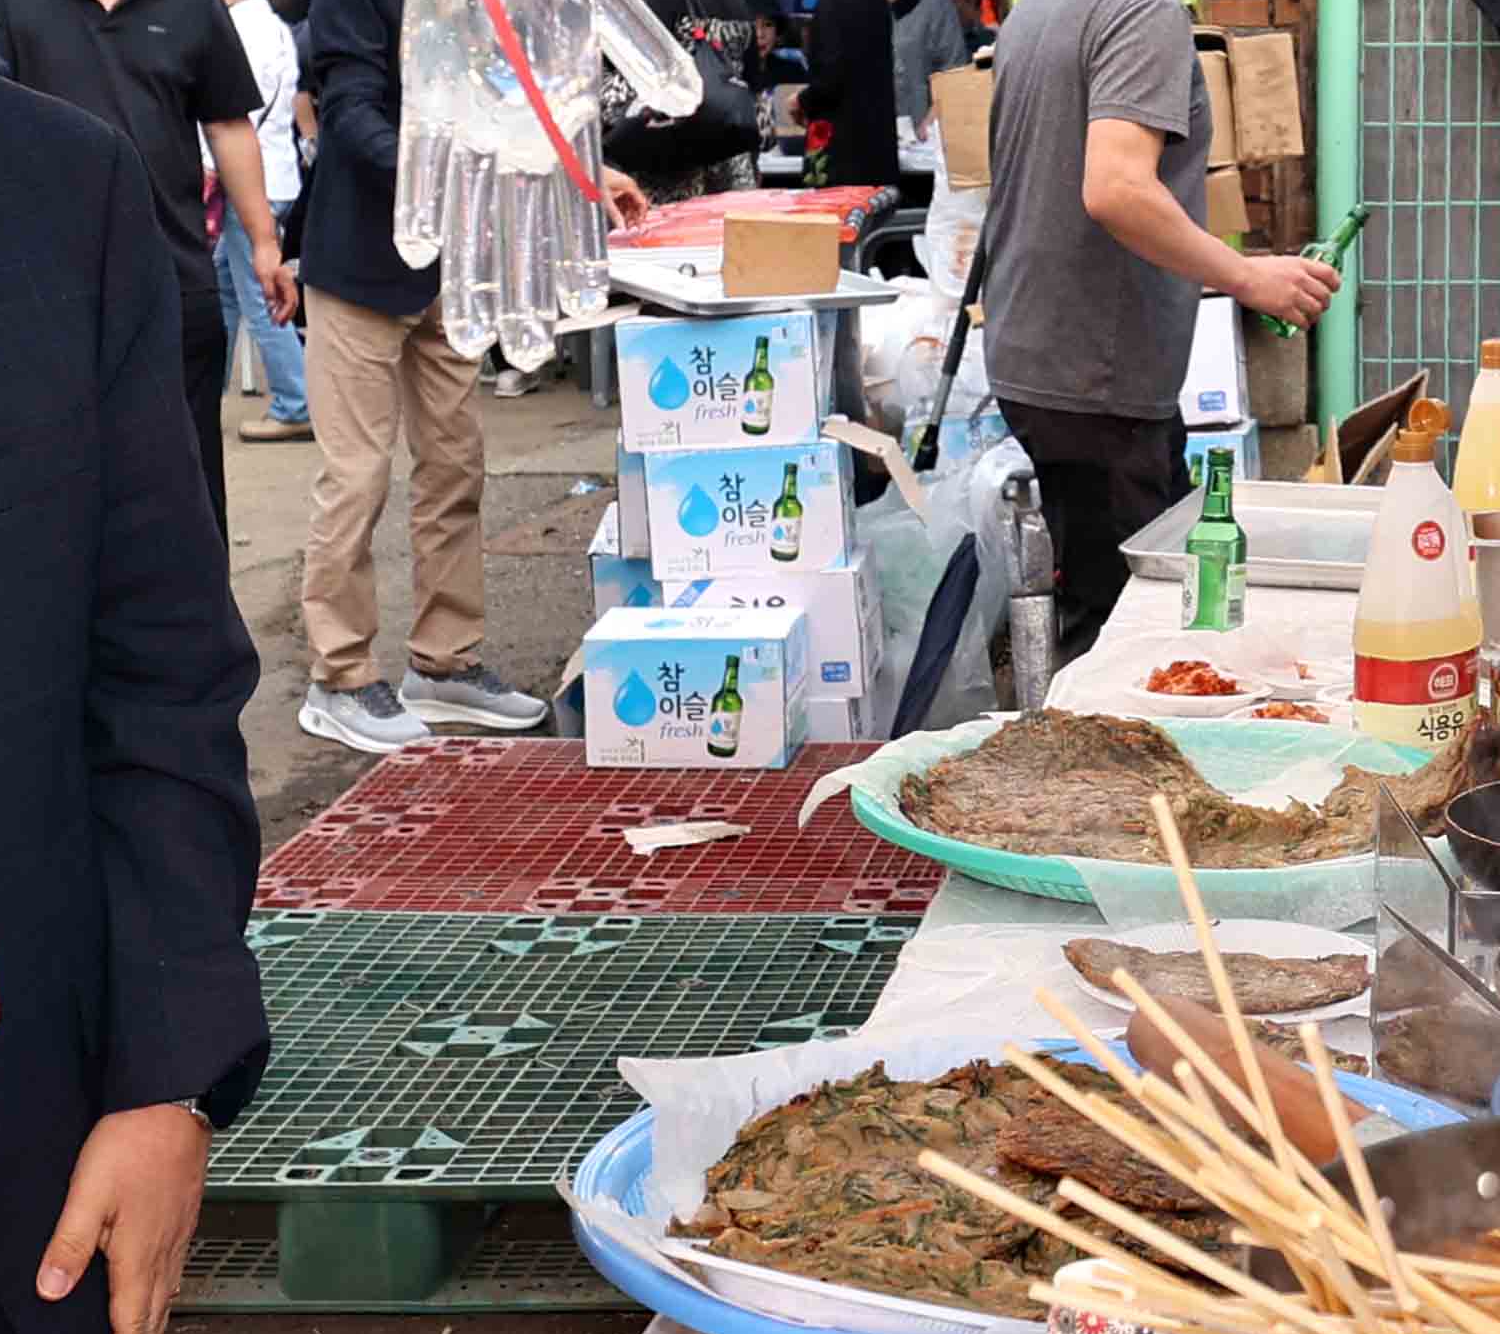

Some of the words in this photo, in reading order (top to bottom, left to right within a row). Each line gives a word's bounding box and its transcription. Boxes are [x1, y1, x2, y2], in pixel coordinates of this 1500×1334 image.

[690, 345, 716, 375] 참
[692, 371, 740, 402] 이슬
[693, 402, 738, 422] fresh
[718, 472, 746, 503] 참
[722, 499, 770, 528] 이슬
[723, 530, 765, 548] fresh
[657, 660, 685, 693] 참
[659, 691, 709, 721] 이슬
[659, 721, 704, 740] fresh
[1417, 710, 1466, 742] 식용유
